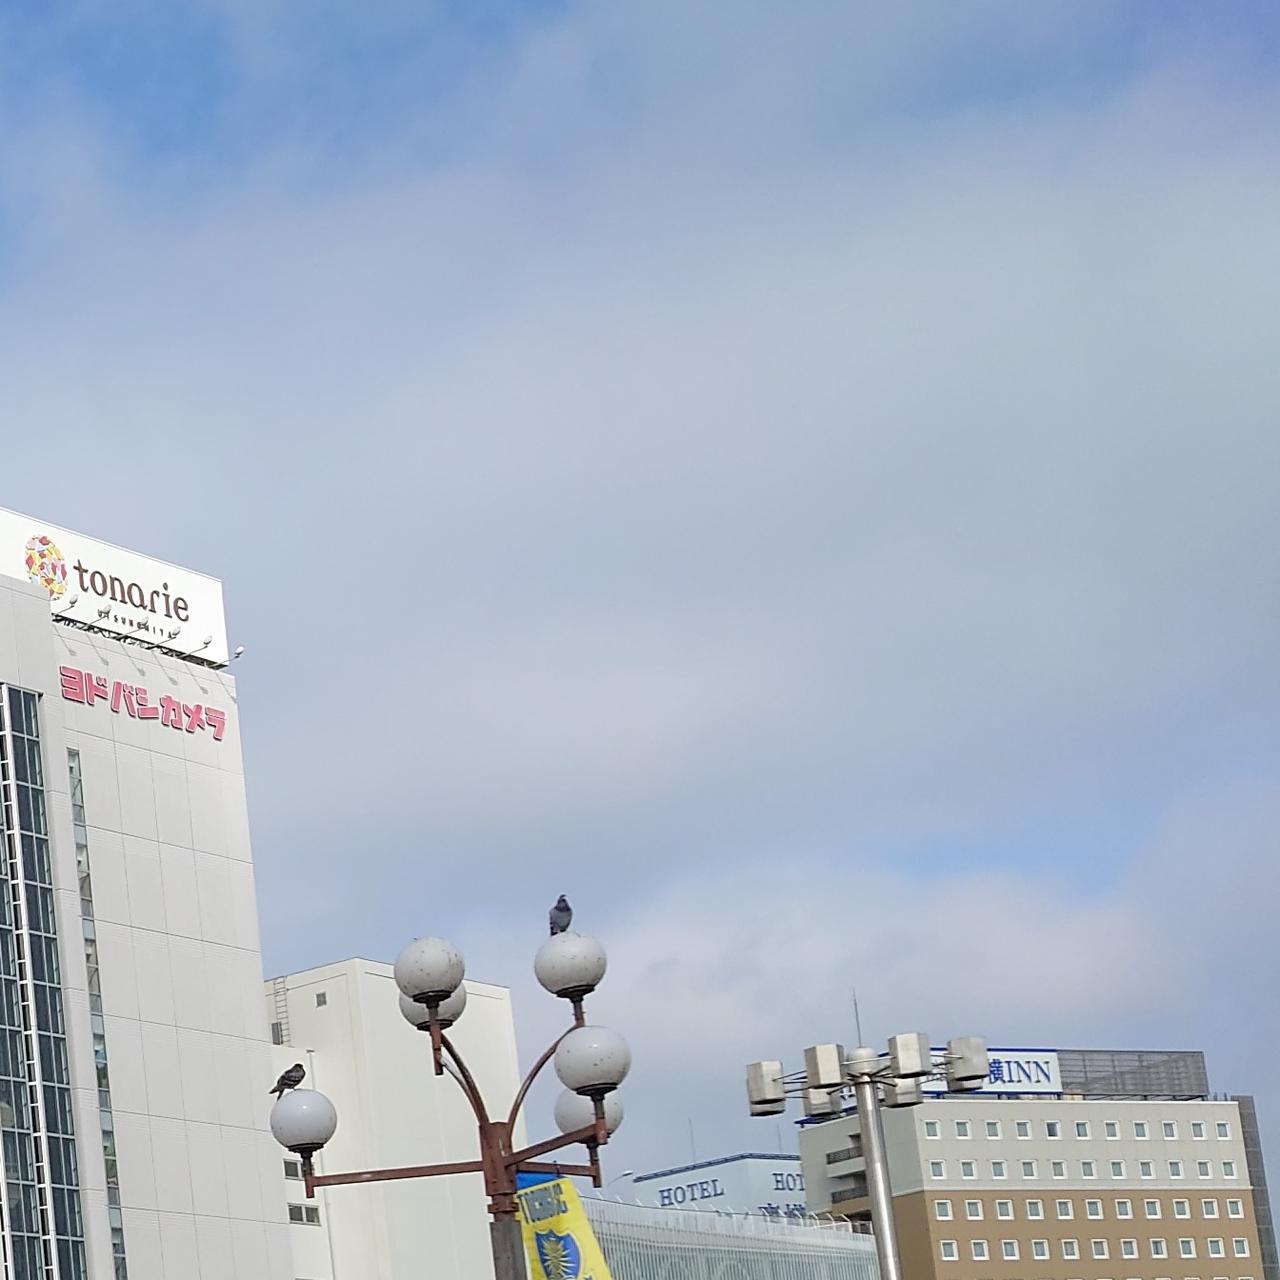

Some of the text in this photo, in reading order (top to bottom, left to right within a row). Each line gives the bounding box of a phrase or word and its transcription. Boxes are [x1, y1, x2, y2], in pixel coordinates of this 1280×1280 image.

[73, 559, 190, 622] tonarie
[59, 665, 227, 741] ヨドバシカメラ
[658, 1178, 724, 1207] HOTEL
